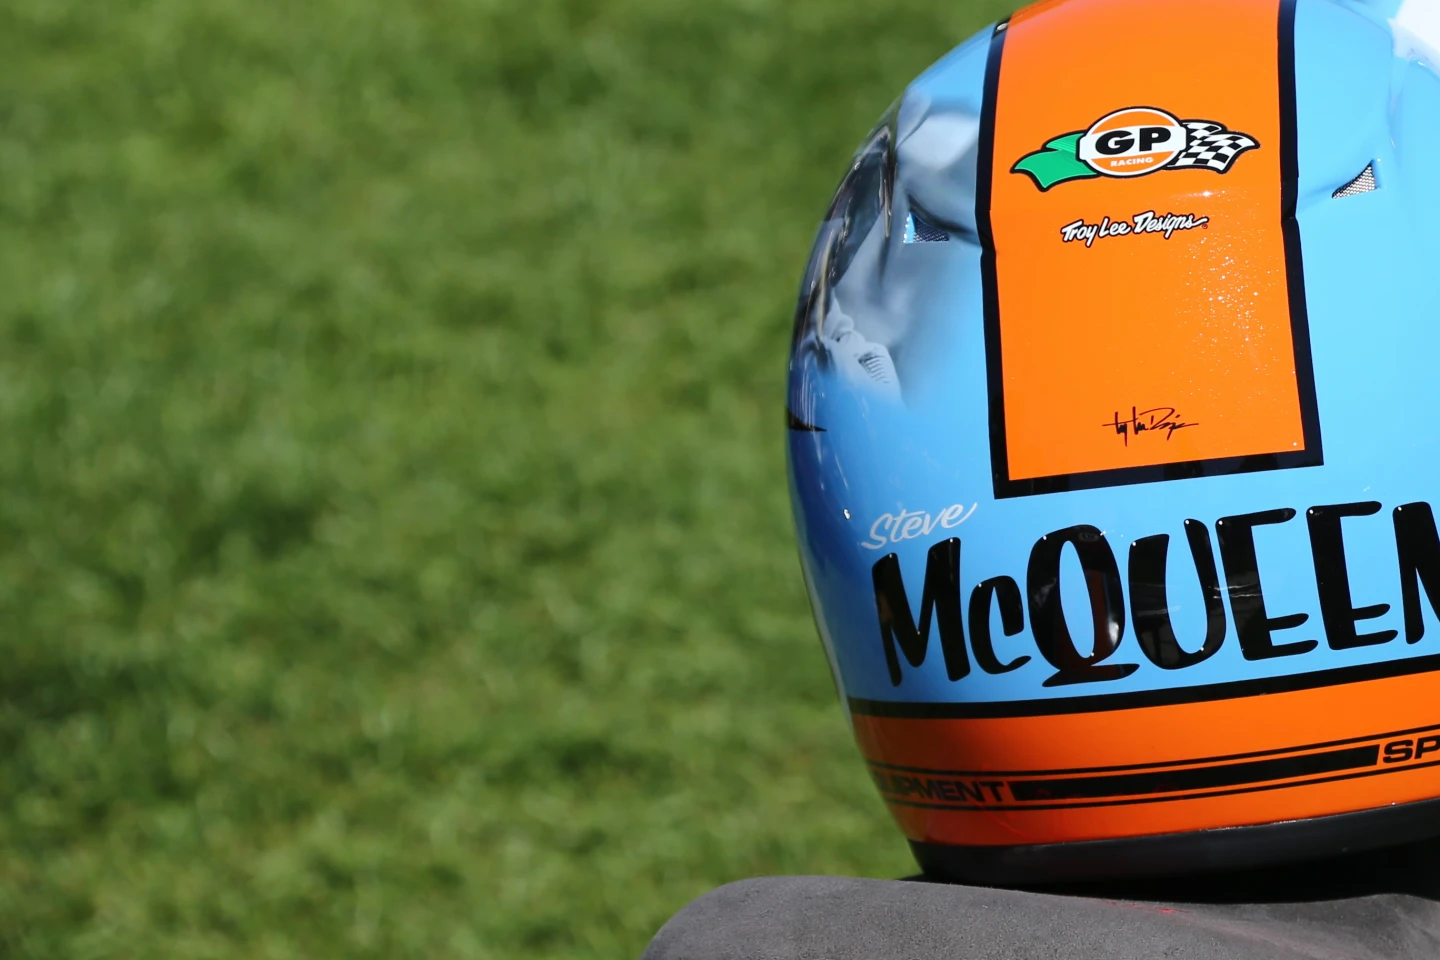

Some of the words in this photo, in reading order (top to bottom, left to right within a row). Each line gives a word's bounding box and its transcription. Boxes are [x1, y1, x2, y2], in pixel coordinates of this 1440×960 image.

[1095, 126, 1172, 156] GP
[1110, 156, 1154, 168] RACING
[1061, 219, 1098, 248] Troy
[1098, 216, 1132, 238] Lee
[1132, 210, 1209, 240] Designs
[860, 501, 978, 550] Steve
